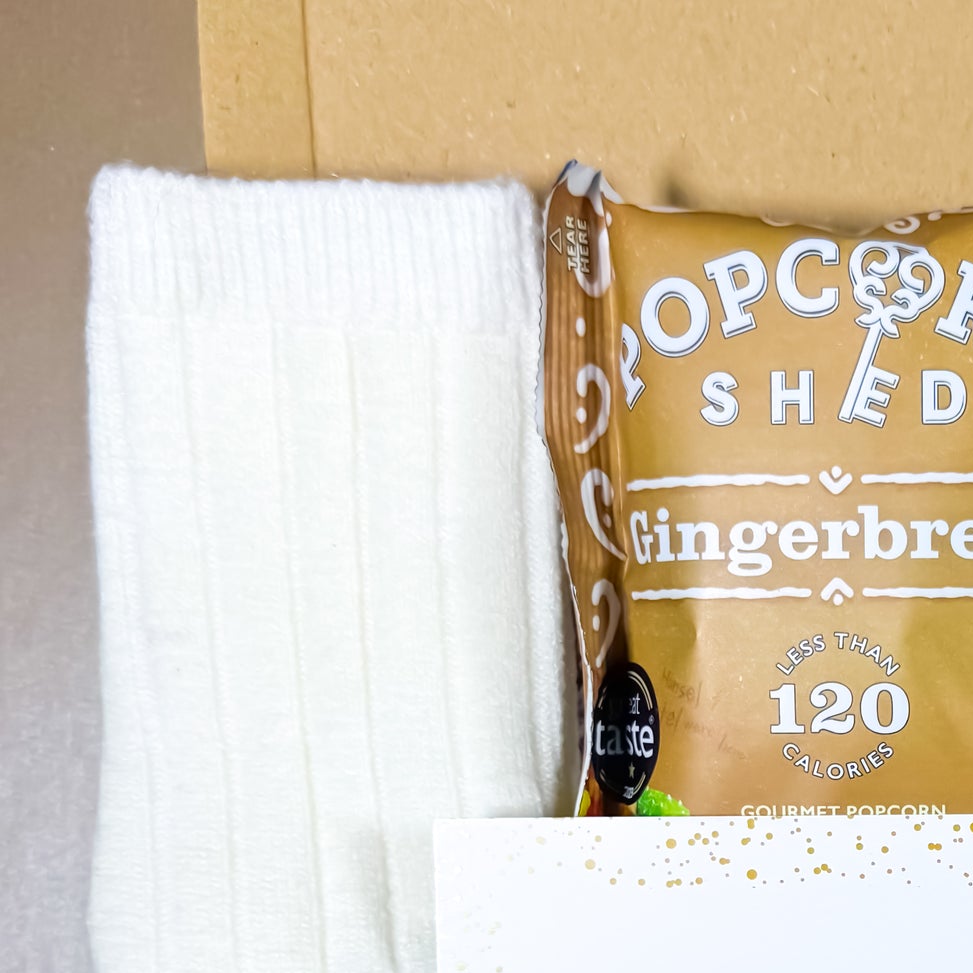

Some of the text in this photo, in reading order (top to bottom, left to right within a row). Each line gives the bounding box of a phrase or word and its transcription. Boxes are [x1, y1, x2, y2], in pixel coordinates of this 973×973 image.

[565, 215, 578, 271] TEAR
[577, 218, 590, 274] HERE
[700, 365, 967, 428] SHED
[776, 631, 900, 676] LESS THAN
[769, 681, 910, 735] 120
[782, 742, 894, 780] CALORIES
